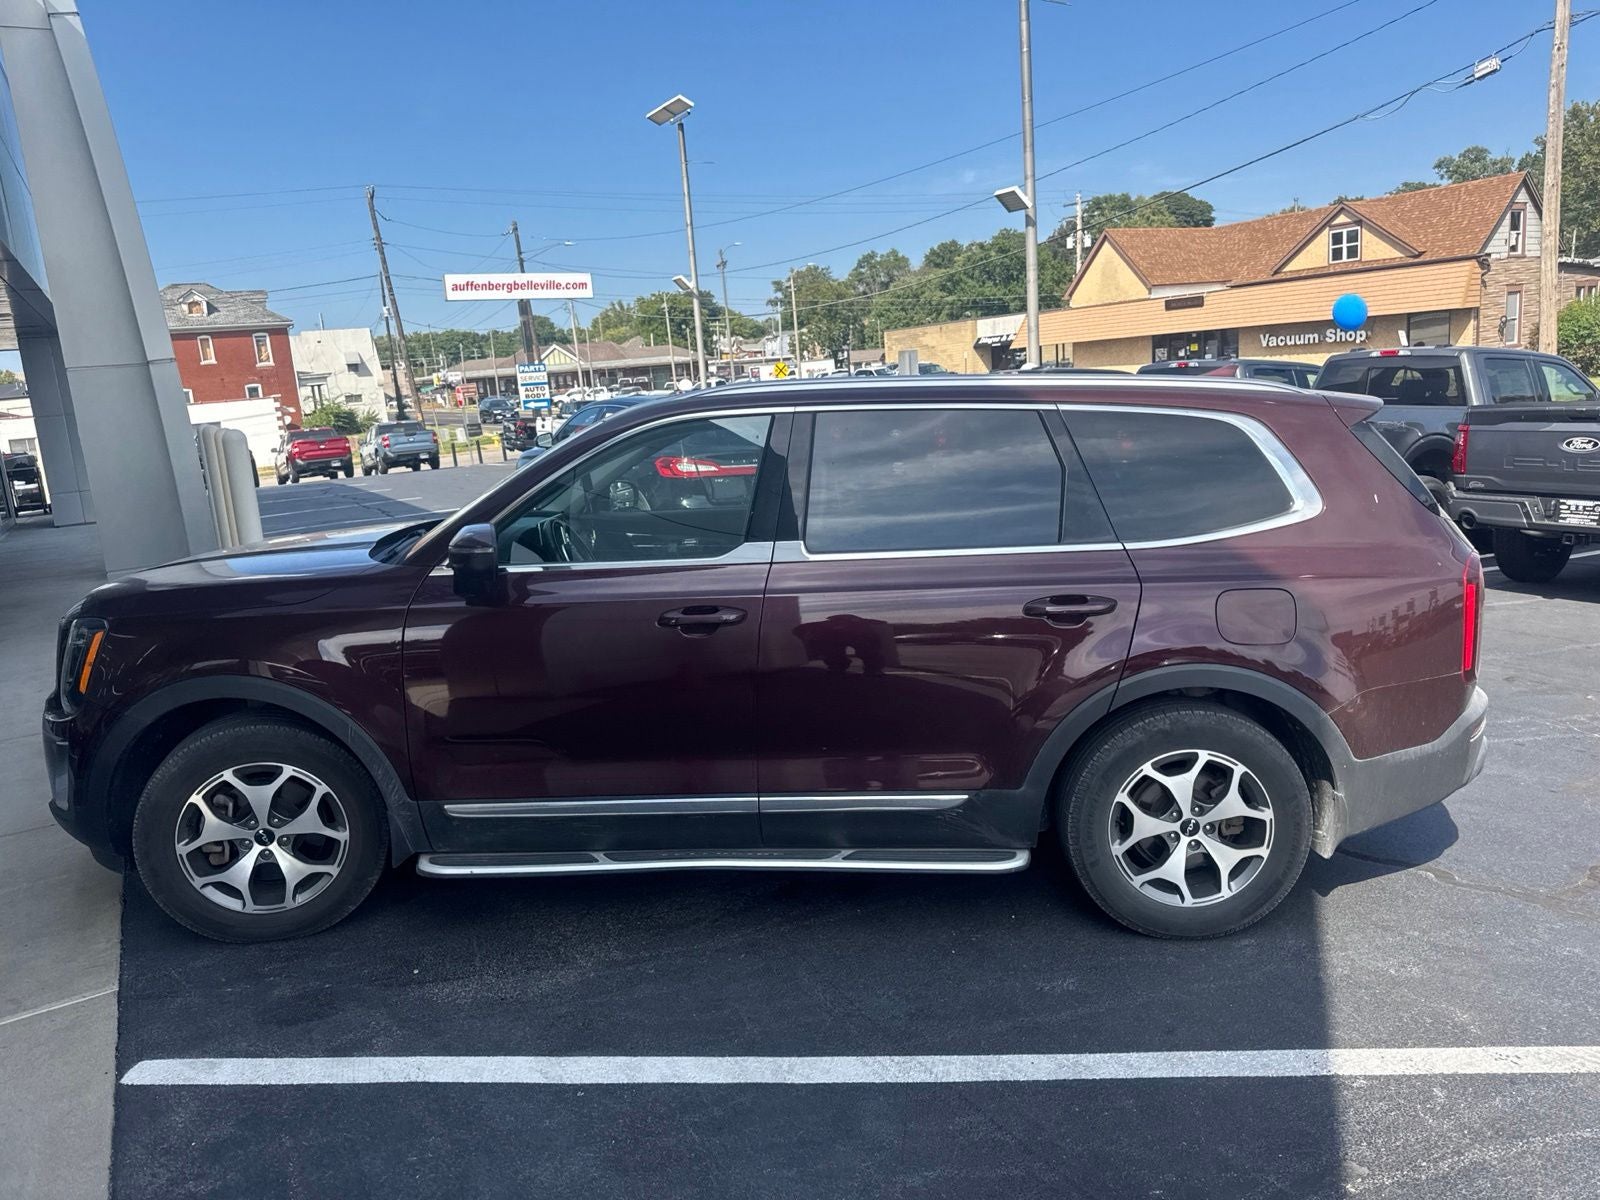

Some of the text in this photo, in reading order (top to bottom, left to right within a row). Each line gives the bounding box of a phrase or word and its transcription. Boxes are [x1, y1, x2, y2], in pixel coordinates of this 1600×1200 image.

[451, 280, 588, 293] auffenbergbelleville.com
[1260, 328, 1366, 347] Vacuum Shop
[519, 365, 546, 373] PARTS
[1569, 438, 1595, 450] Ford
